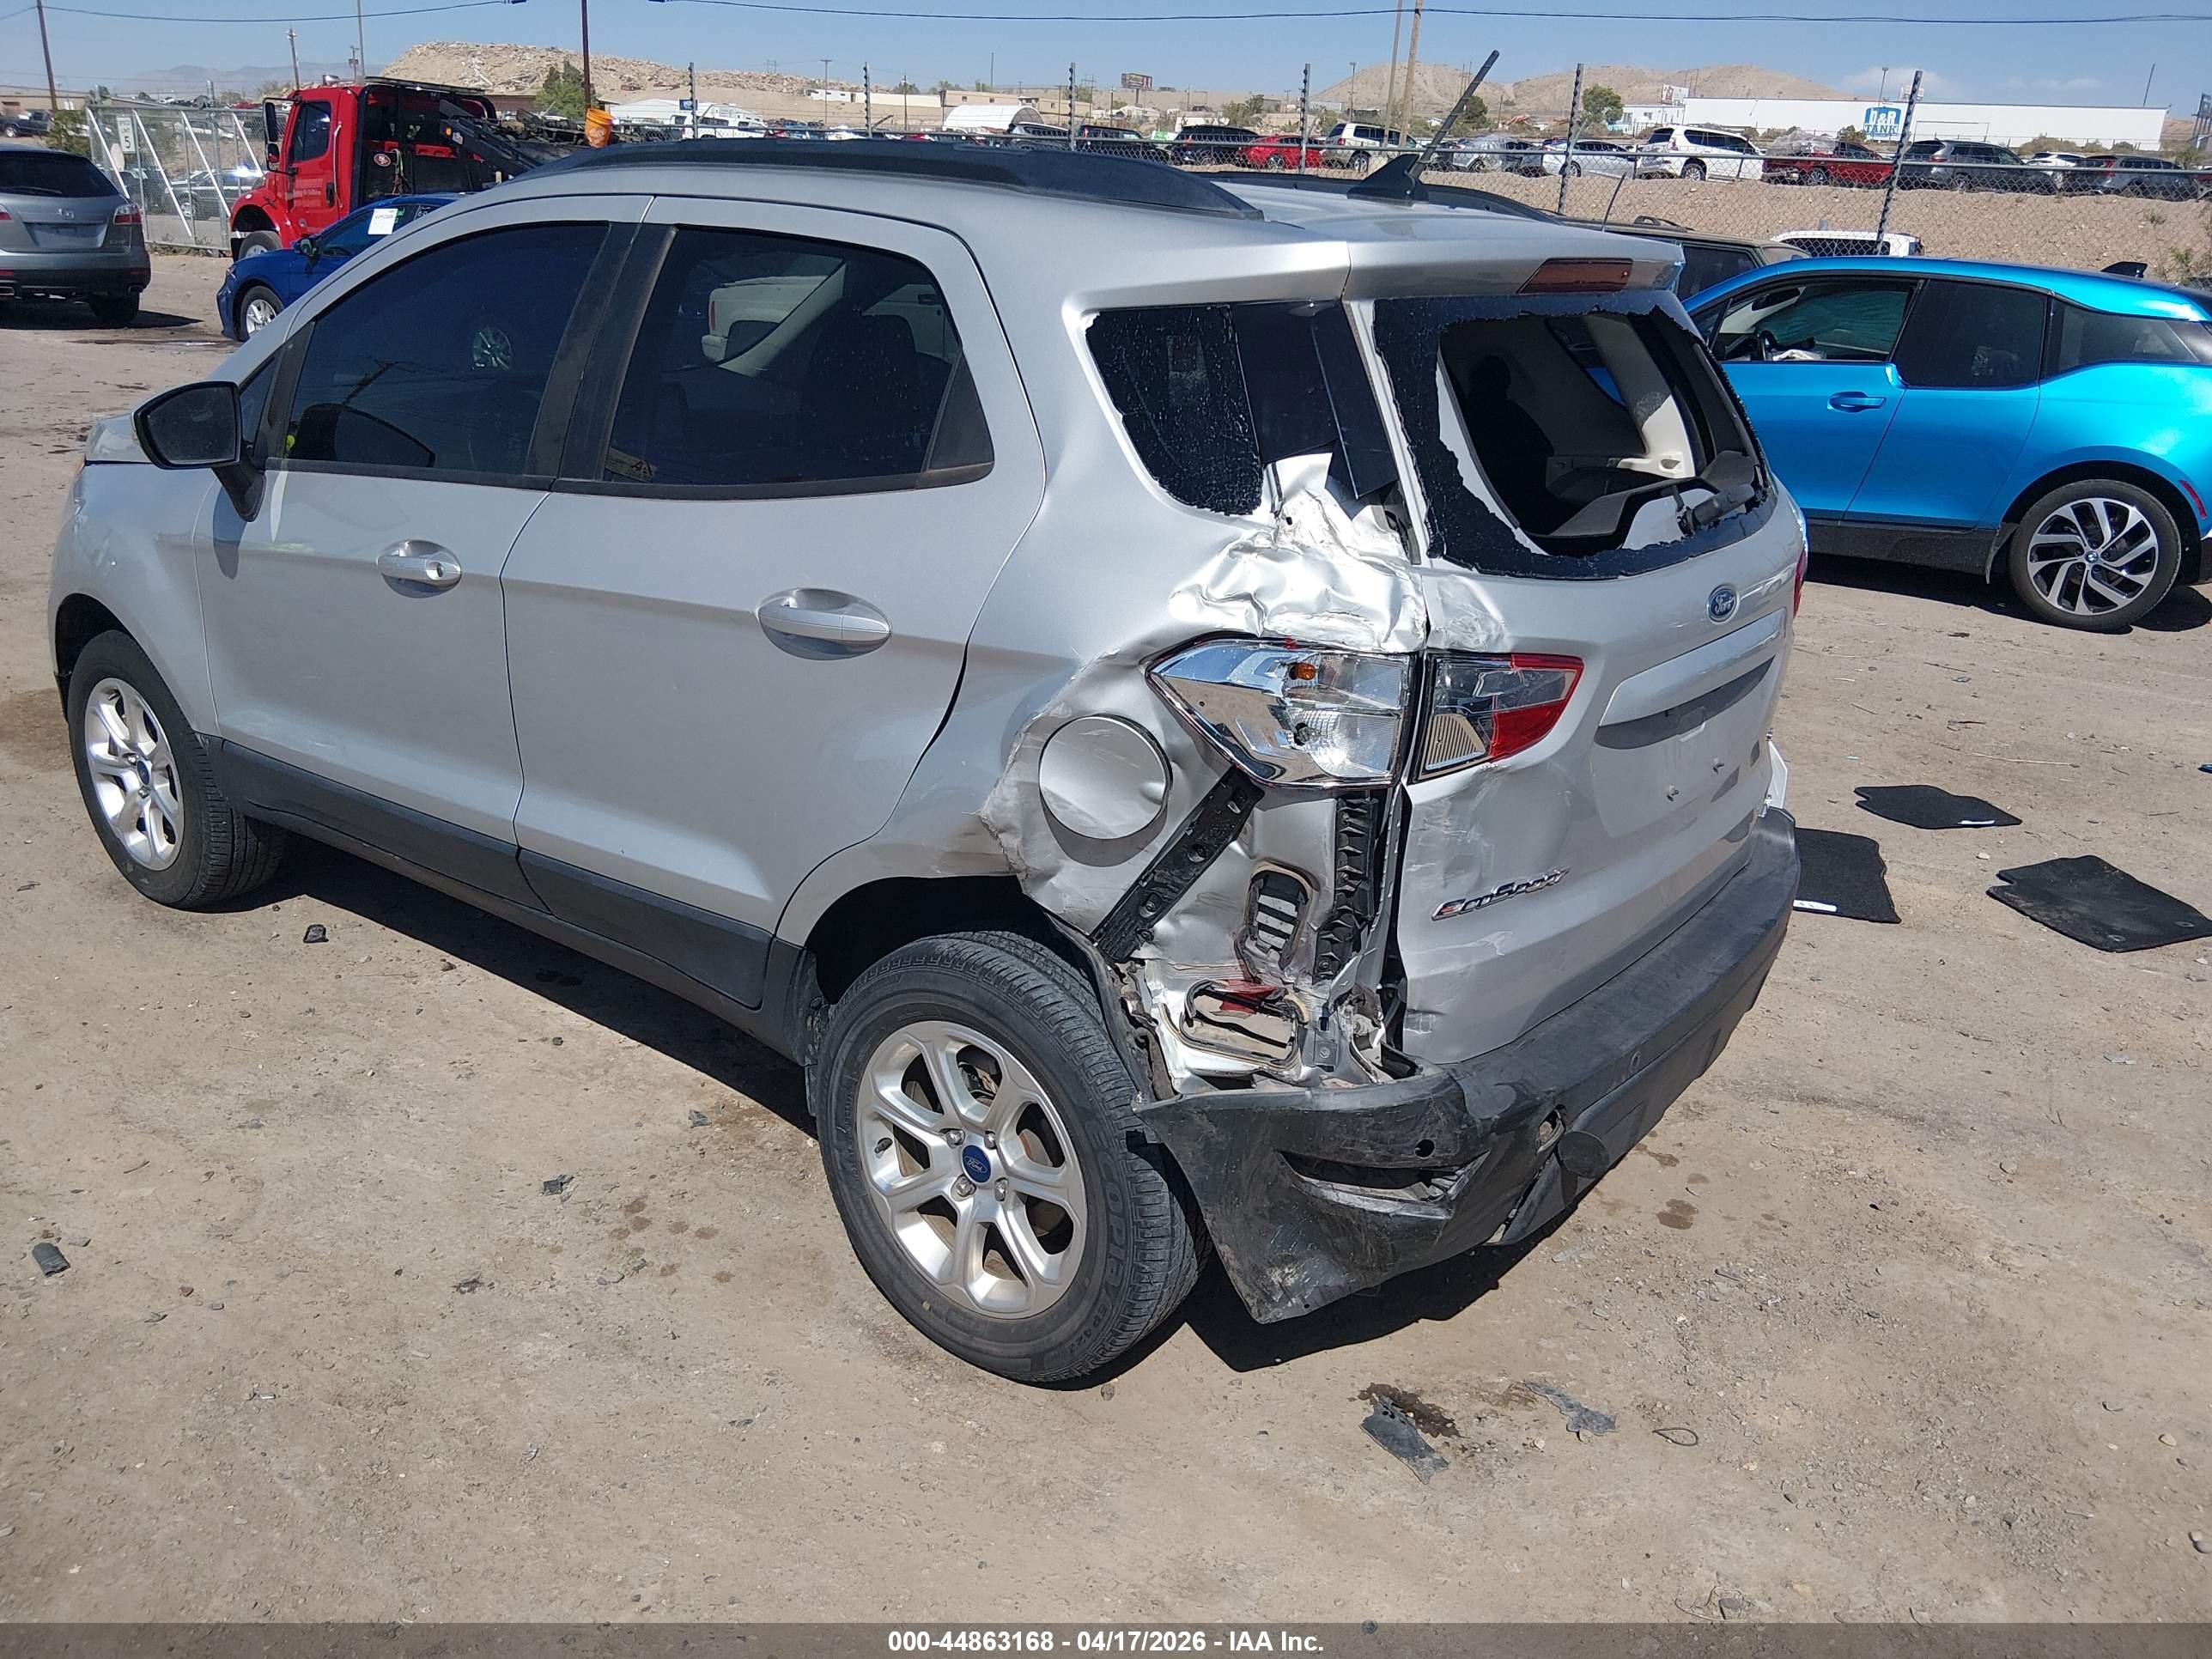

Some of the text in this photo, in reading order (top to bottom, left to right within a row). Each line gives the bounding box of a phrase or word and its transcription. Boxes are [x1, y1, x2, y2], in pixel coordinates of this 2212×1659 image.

[1864, 125, 1897, 133] TANK
[124, 136, 131, 149] 5
[1431, 868, 1570, 921] EcoSport
